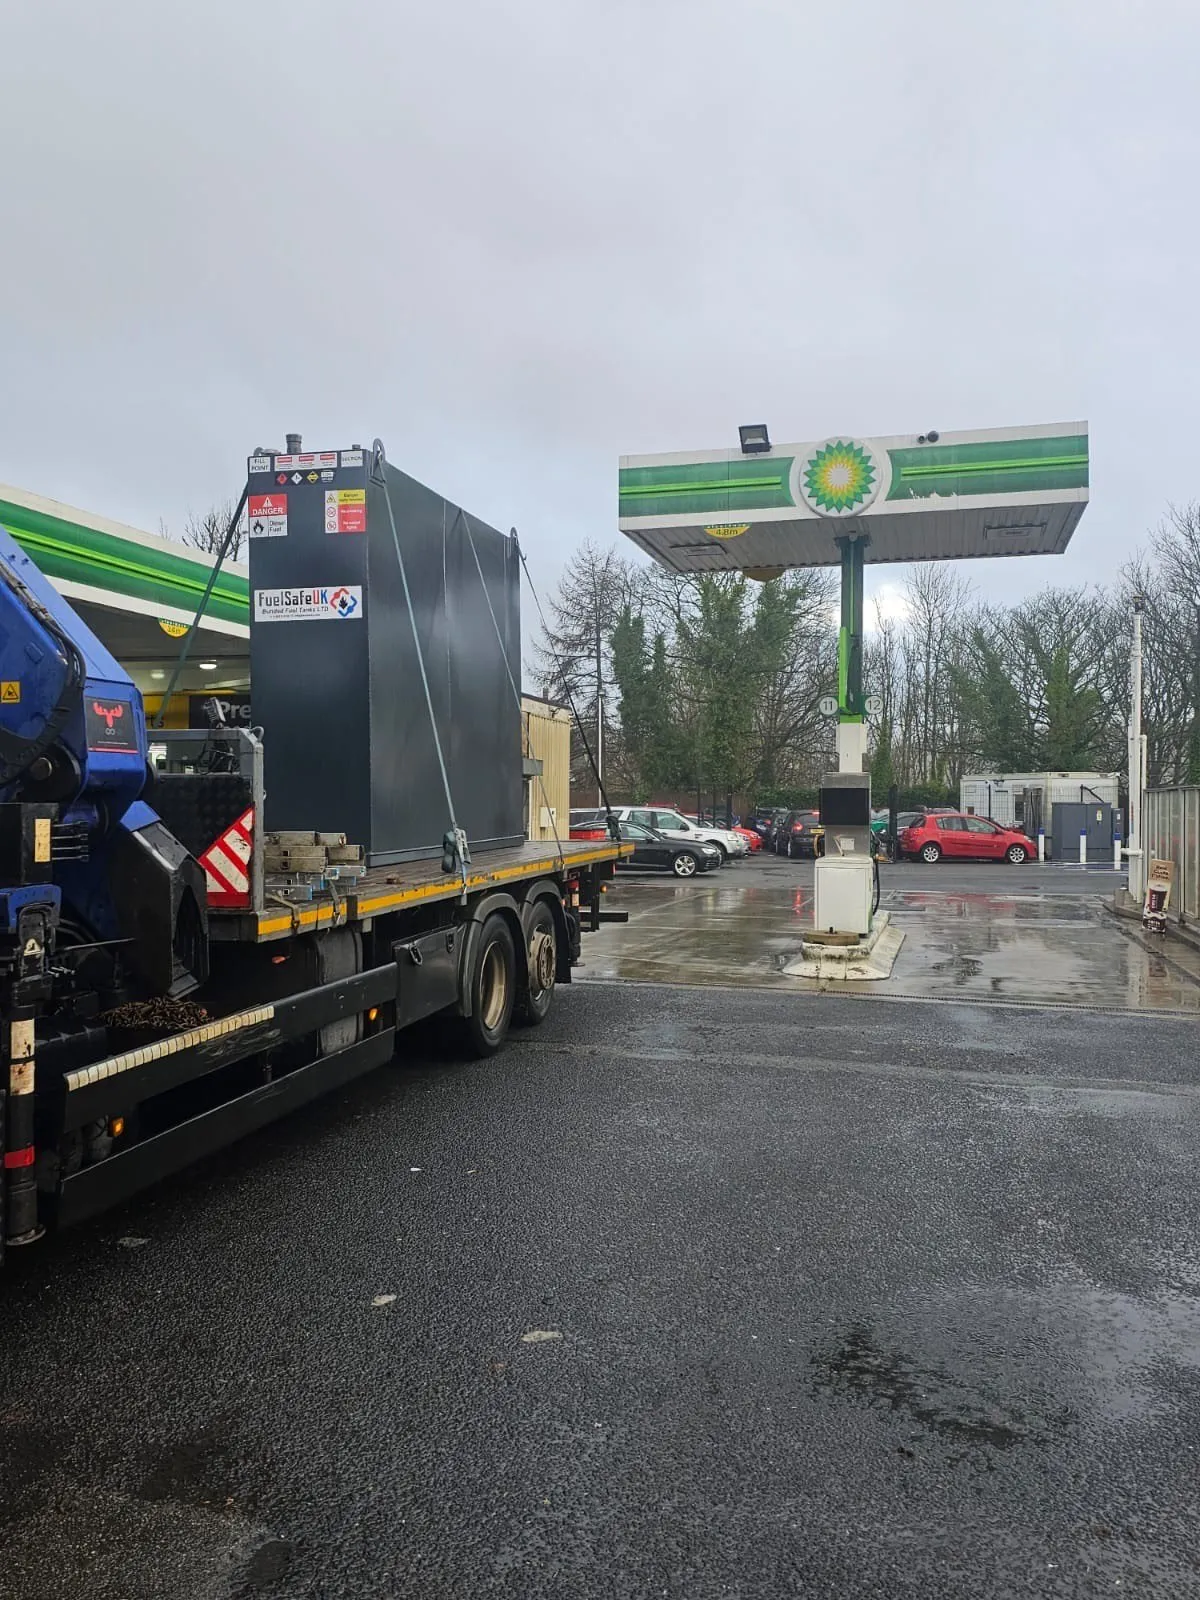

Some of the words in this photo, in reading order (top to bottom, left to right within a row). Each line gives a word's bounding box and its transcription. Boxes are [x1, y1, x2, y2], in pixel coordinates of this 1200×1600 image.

[252, 507, 284, 516] DANGER
[258, 589, 328, 607] FuelSafeUK
[823, 701, 833, 711] 11
[868, 699, 881, 711] 12
